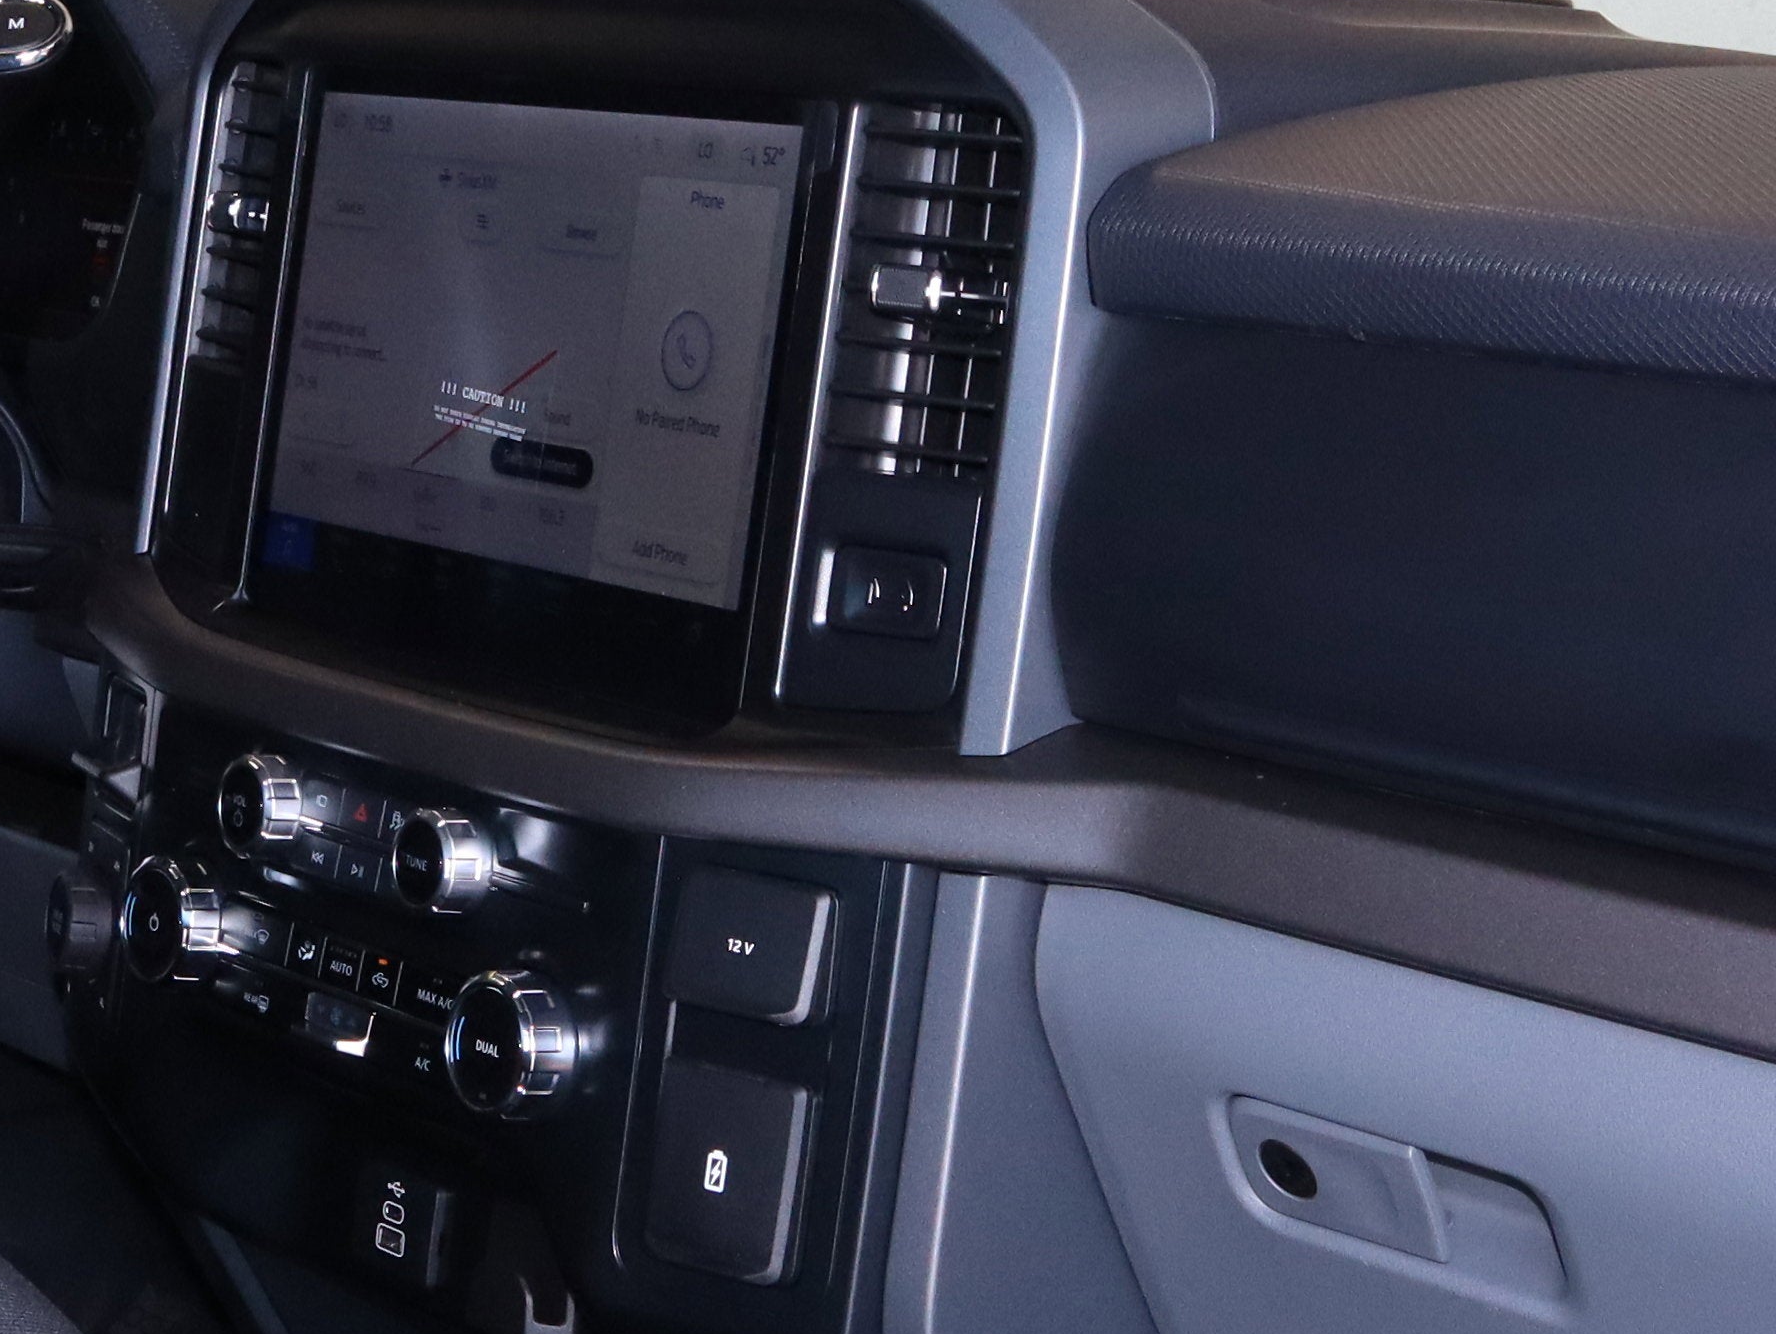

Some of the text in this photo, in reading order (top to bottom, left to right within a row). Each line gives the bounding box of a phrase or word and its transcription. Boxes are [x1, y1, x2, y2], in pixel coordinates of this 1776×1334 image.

[8, 17, 25, 30] M
[761, 145, 786, 166] 52°
[690, 190, 726, 211] Phone
[462, 386, 505, 408] CAUTION
[634, 408, 722, 439] No Paired Phone
[631, 539, 688, 568] Add Phone
[405, 853, 429, 872] TUNE
[727, 937, 756, 956] 12 V
[329, 958, 354, 978] AUTO
[416, 987, 455, 1011] MAX A/C
[475, 1038, 500, 1059] DUAL
[414, 1055, 432, 1072] A/C
